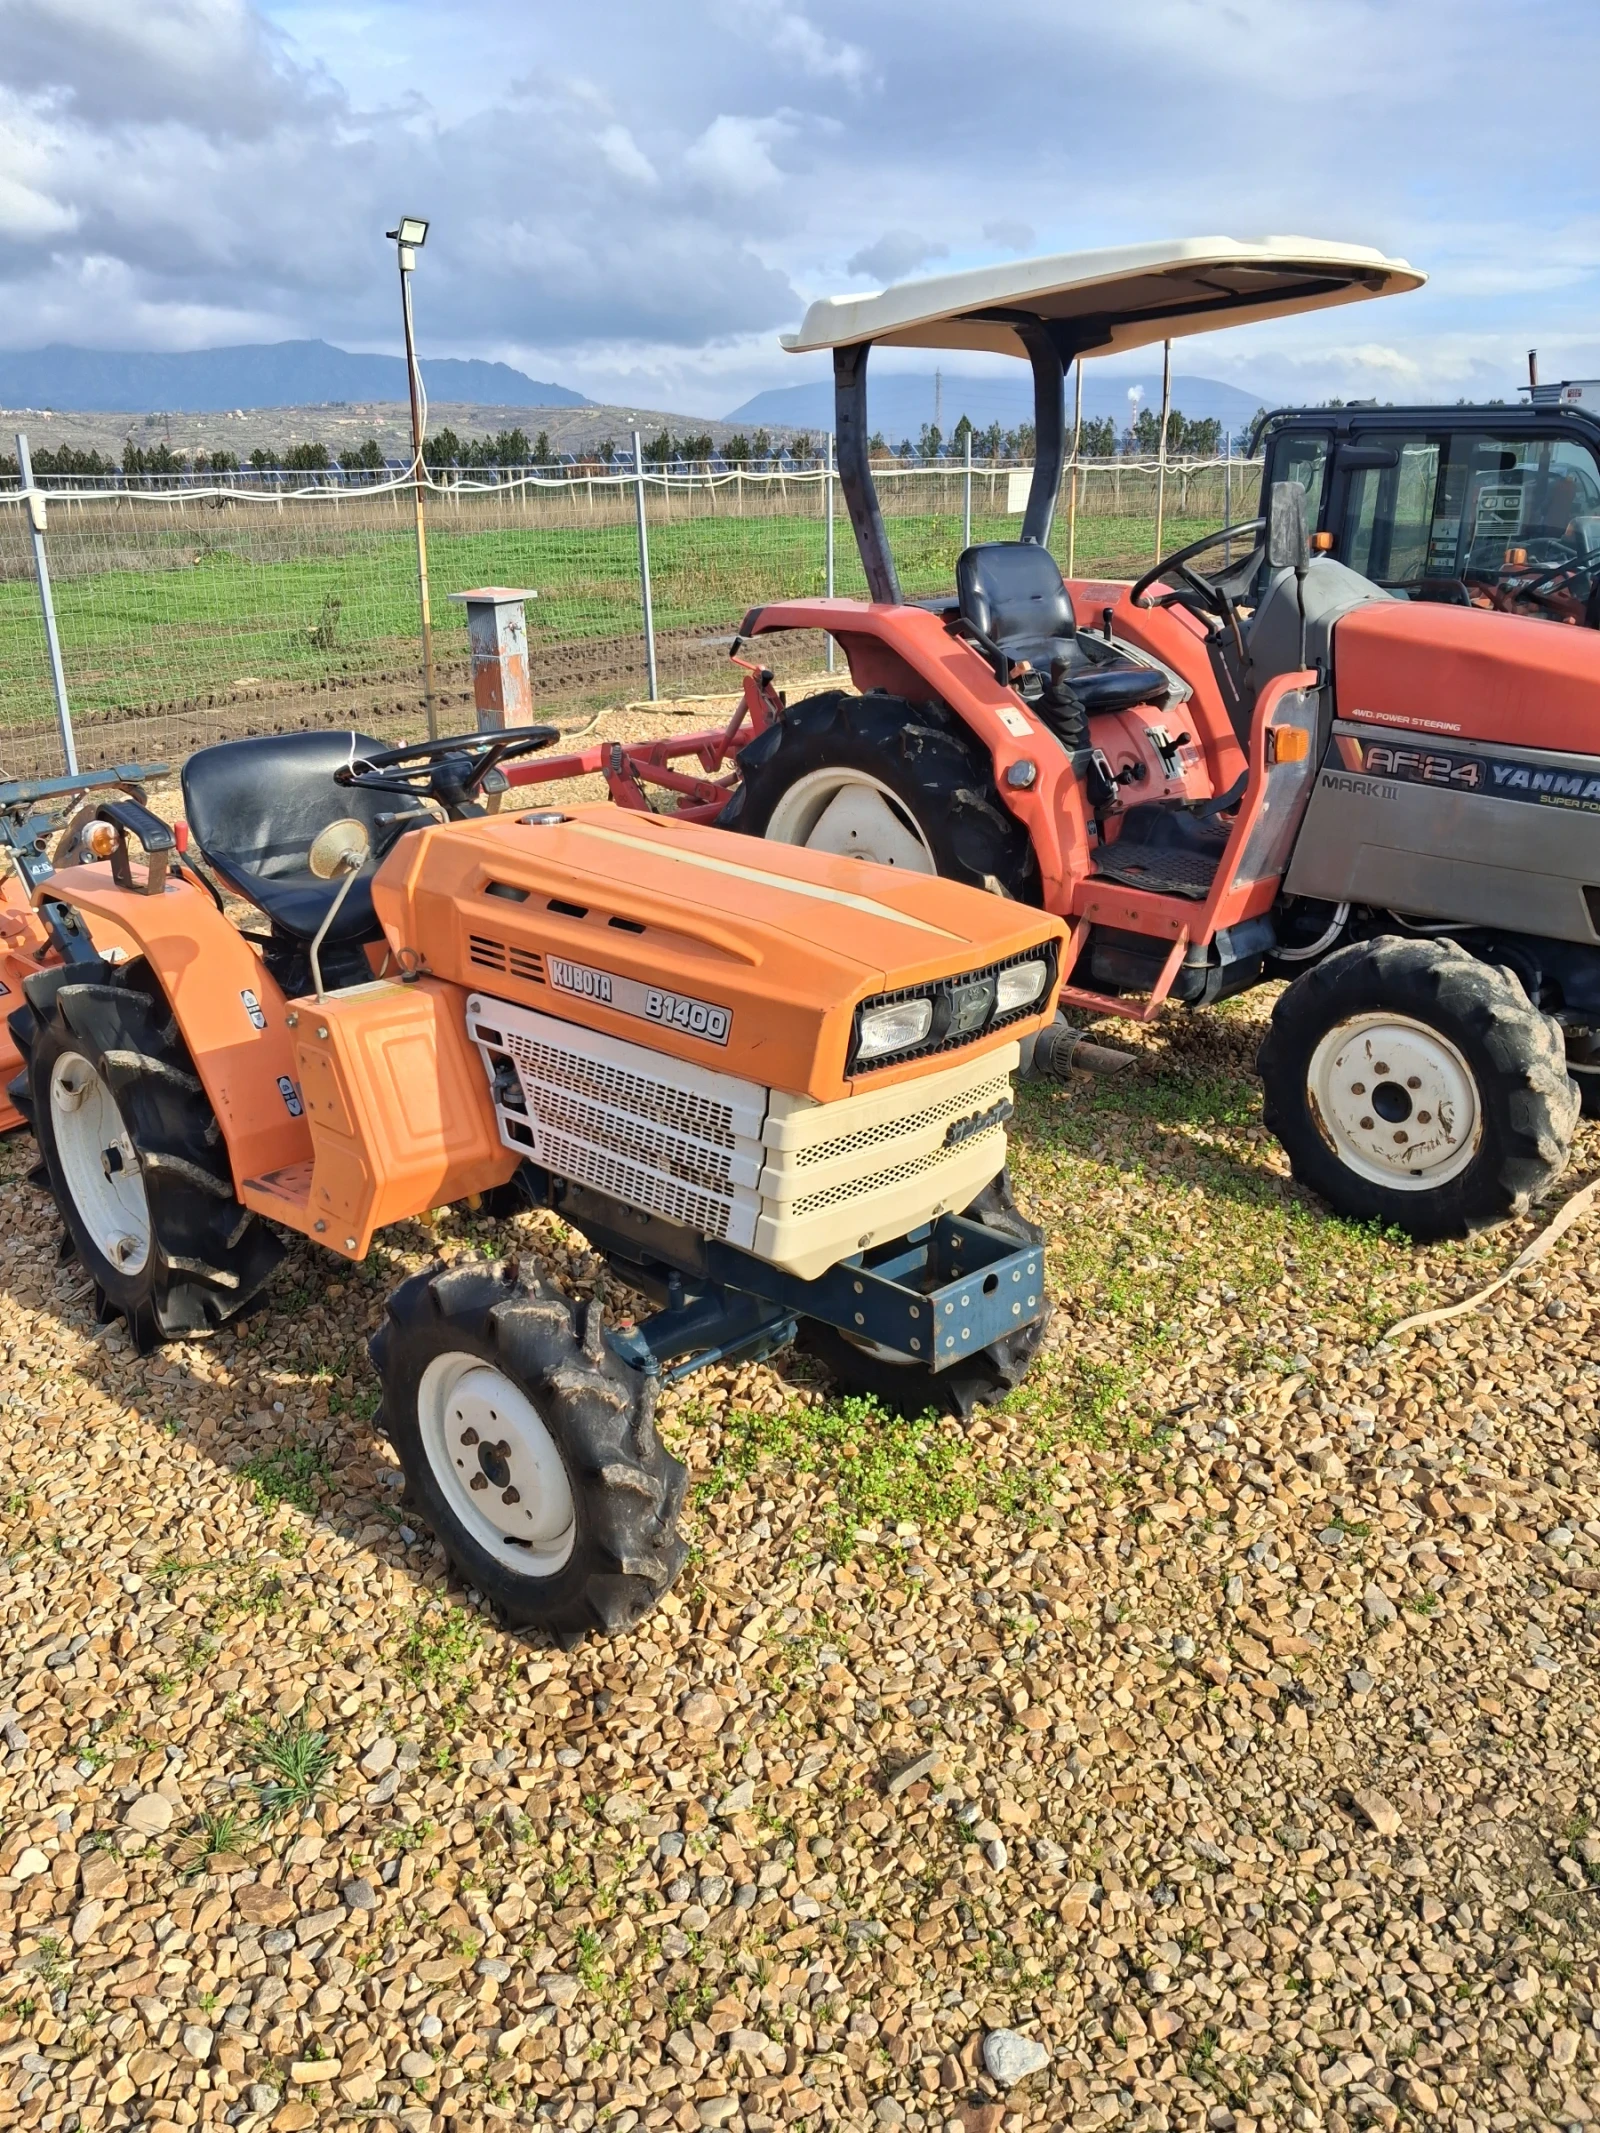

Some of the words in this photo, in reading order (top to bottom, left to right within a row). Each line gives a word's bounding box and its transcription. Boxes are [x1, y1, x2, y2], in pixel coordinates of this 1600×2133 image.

[1376, 712, 1410, 724] POWER
[1411, 717, 1462, 732] STEERING
[1322, 775, 1380, 798] MARK
[1540, 794, 1580, 808] SUPER
[1581, 801, 1600, 811] FO
[552, 959, 613, 1003] KUBOTA
[645, 989, 728, 1039] B1400
